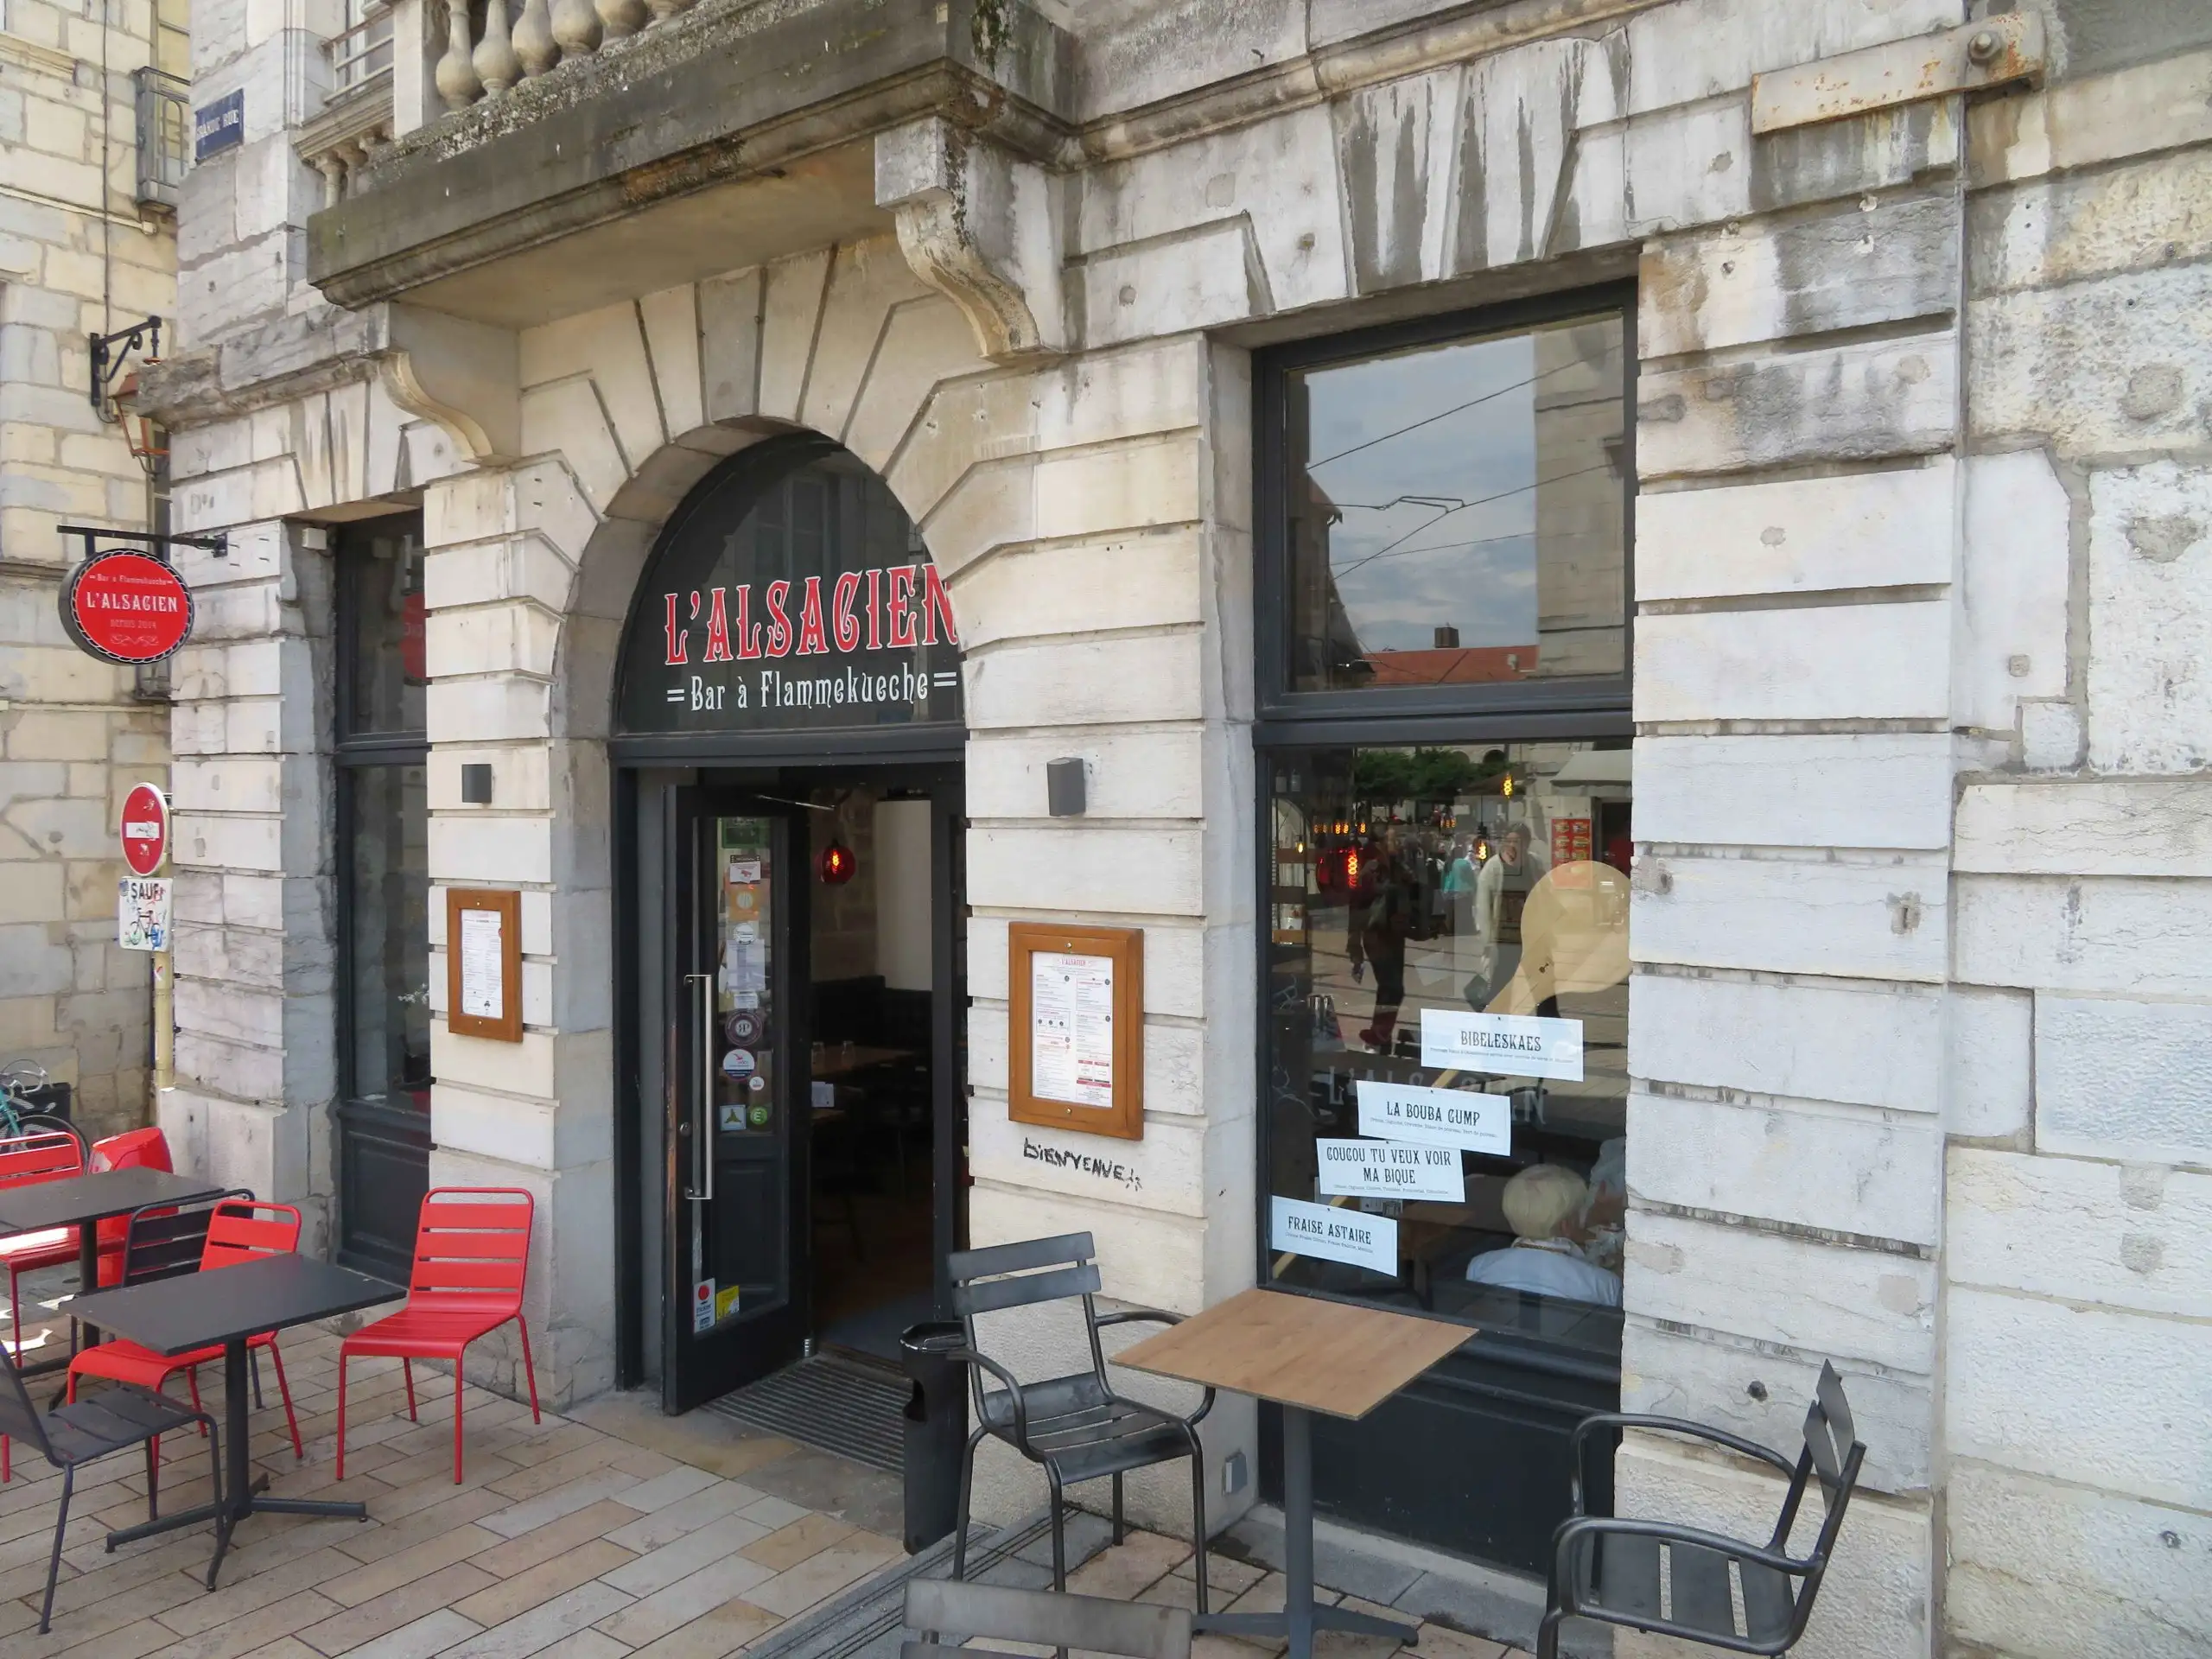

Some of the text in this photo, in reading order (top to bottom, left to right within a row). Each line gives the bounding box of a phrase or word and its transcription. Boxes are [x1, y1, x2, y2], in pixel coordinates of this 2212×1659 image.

[86, 591, 178, 613] L'ALSACIEN
[664, 563, 958, 665] L'ALSACIEN
[691, 662, 928, 711] Bar à Flammekueche
[130, 882, 160, 900] SAUF
[1461, 1030, 1542, 1052] BIBELESKAES
[1387, 1101, 1480, 1126] LA BOUBA GUMP
[1326, 1147, 1452, 1166] COUCOU TU VEUX VOIR
[1363, 1167, 1416, 1185] MA BIQUE
[1288, 1216, 1324, 1235] FRAISE
[1328, 1224, 1372, 1245] ASTAIRE
